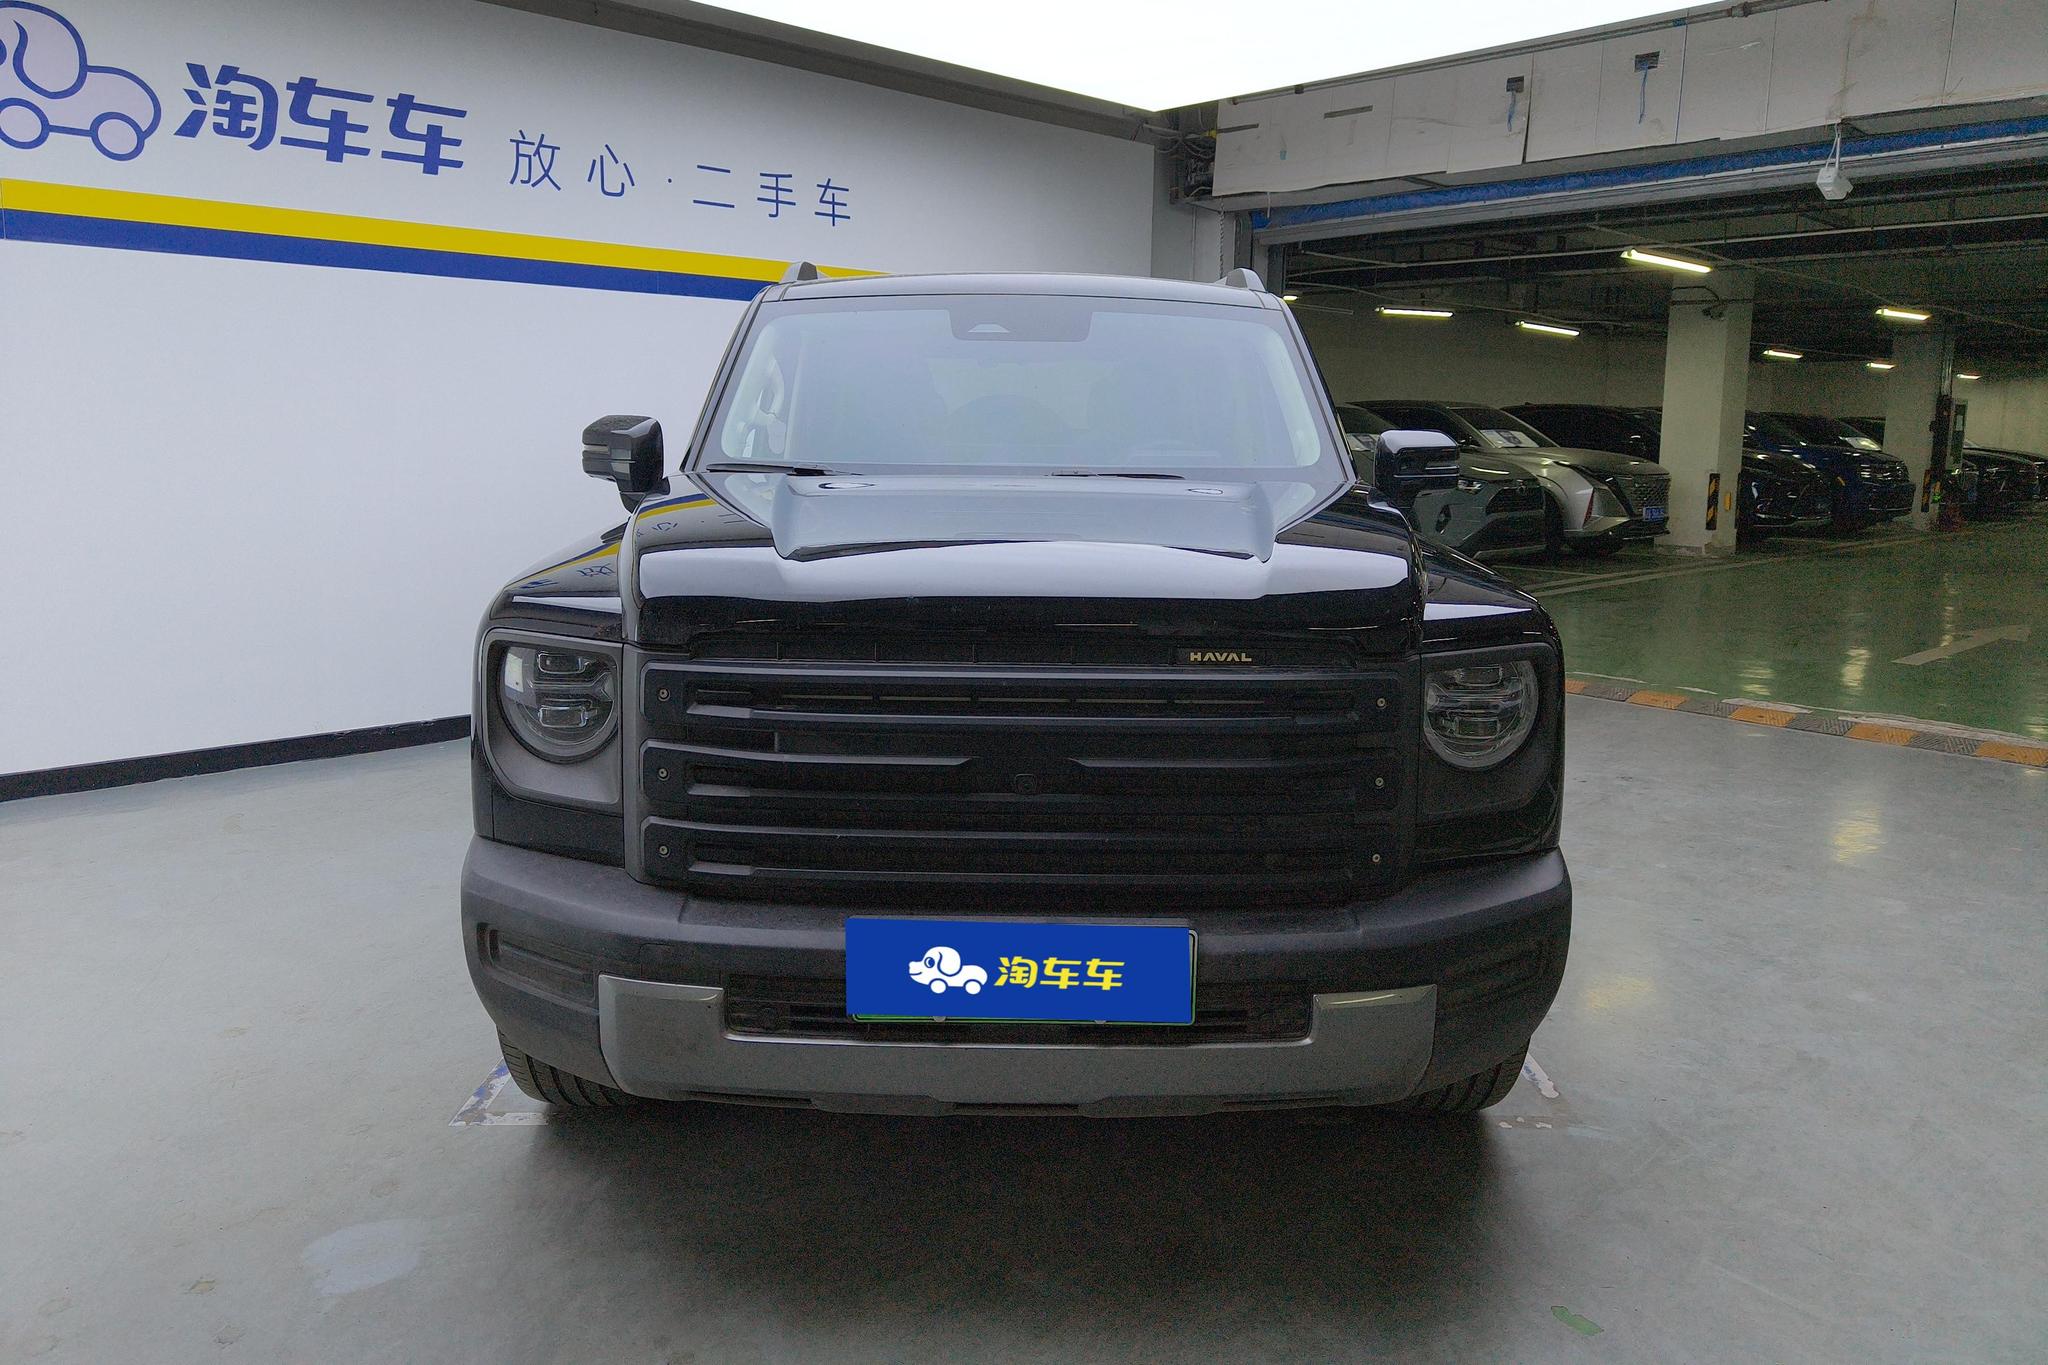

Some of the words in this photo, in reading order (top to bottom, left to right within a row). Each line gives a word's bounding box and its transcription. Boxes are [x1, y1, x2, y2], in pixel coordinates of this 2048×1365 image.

[174, 62, 468, 176] 淘车车
[1190, 652, 1252, 662] HAVAL
